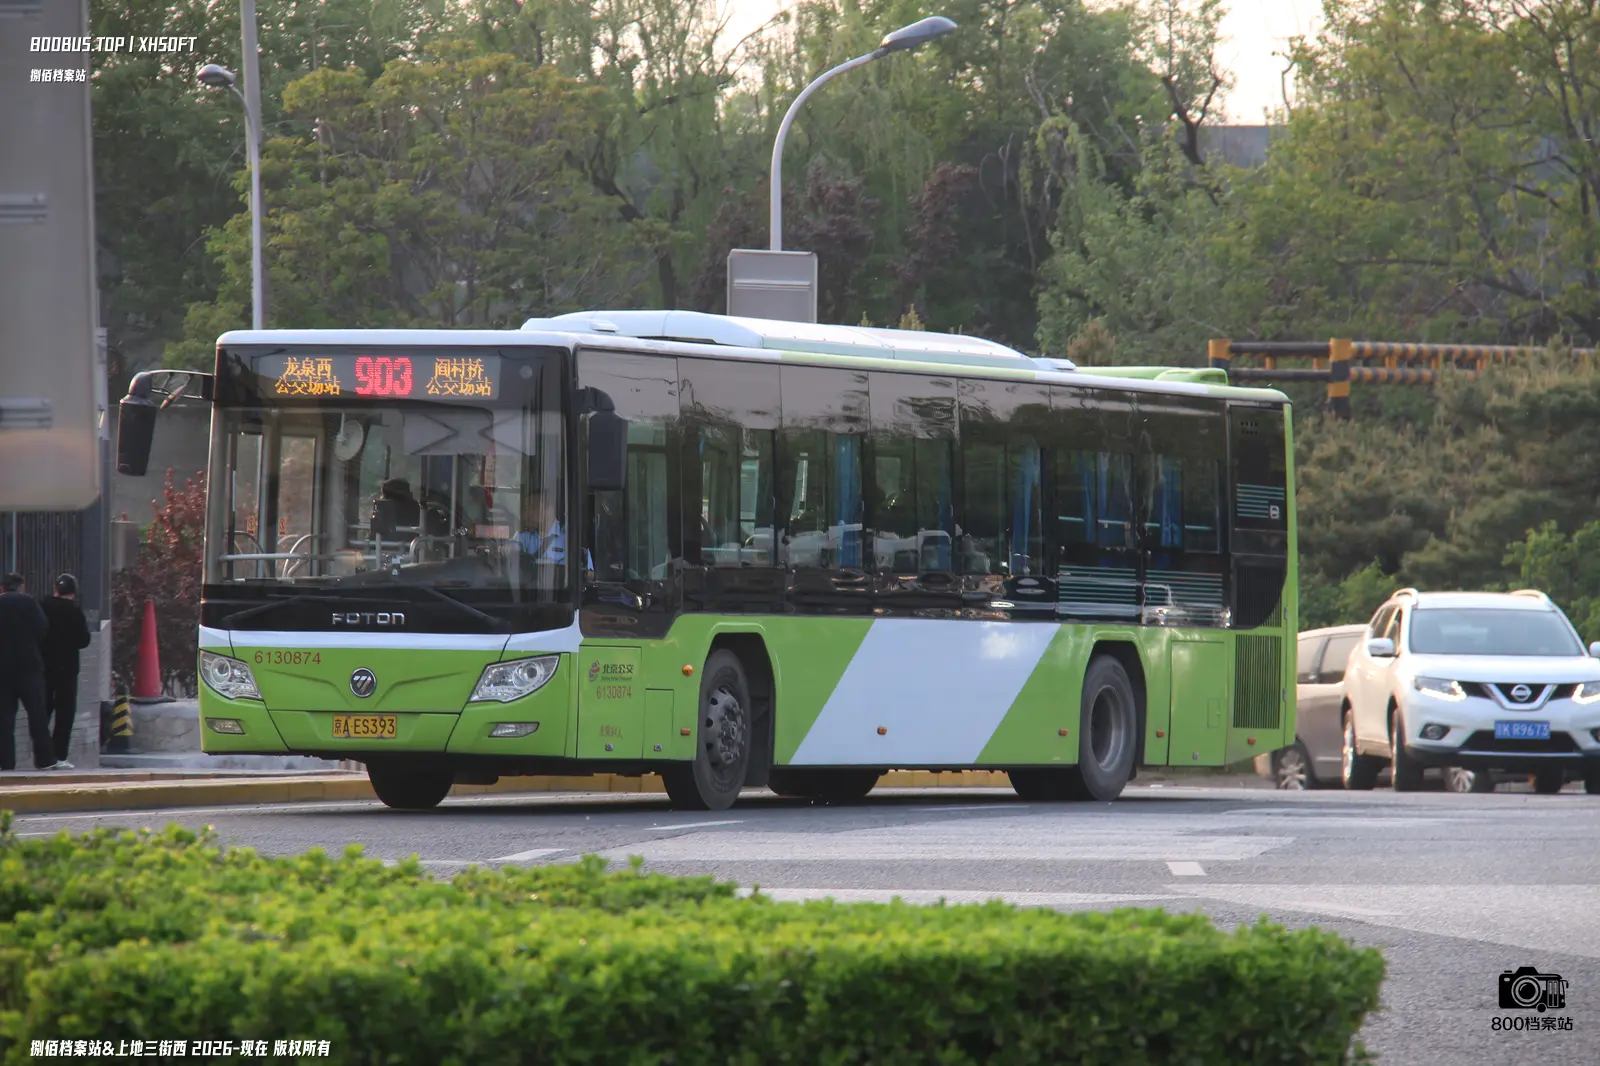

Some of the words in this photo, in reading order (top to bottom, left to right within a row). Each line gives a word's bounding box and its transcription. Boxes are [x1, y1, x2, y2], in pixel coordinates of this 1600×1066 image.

[283, 357, 332, 377] 龙泉西
[355, 357, 413, 395] 903
[274, 376, 341, 396] 公交场站
[426, 376, 492, 396] 公交场站
[332, 612, 405, 625] FOTON
[254, 651, 322, 665] 6130874
[602, 664, 634, 674] 北京公交
[596, 686, 632, 699] 6130874
